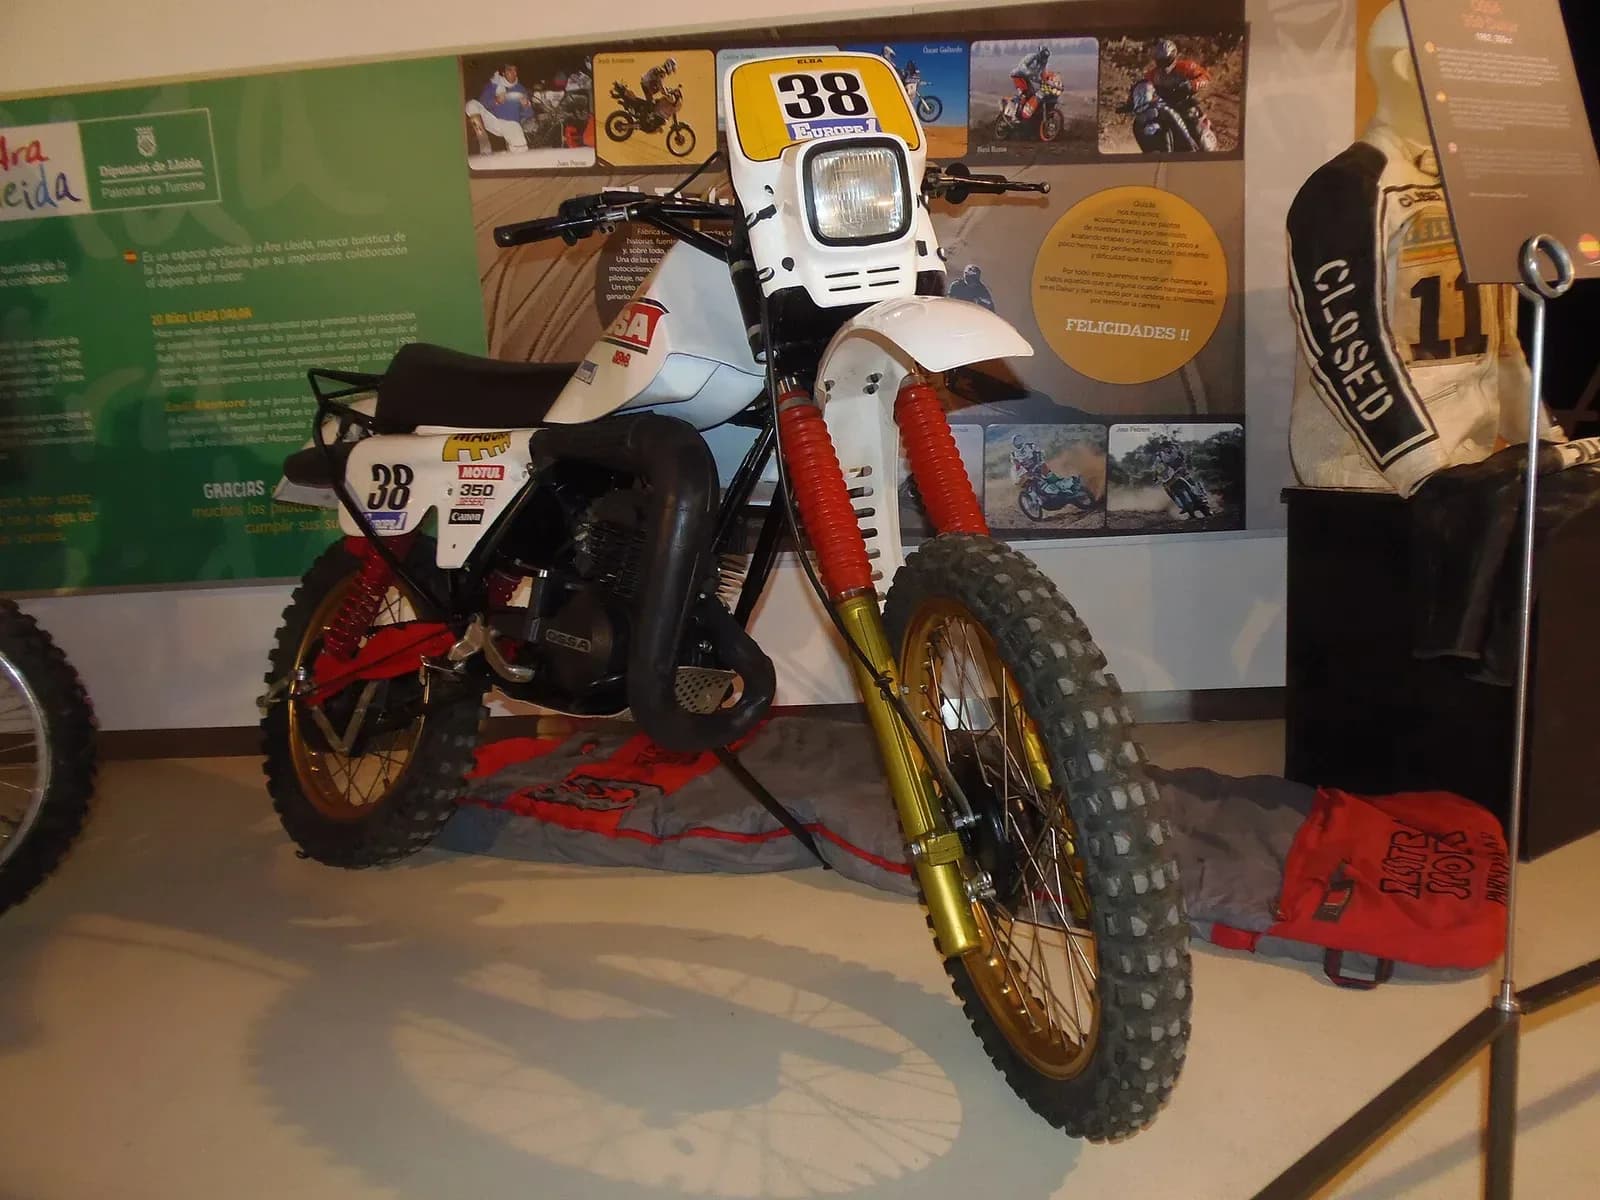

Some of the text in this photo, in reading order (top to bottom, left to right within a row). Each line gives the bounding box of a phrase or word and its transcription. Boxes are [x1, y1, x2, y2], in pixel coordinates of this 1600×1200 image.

[777, 72, 869, 119] 38
[394, 230, 407, 243] de
[629, 246, 648, 254] sobre
[616, 255, 630, 264] Una
[630, 255, 639, 264] de
[611, 283, 622, 291] Un
[1410, 271, 1489, 360] 11
[1065, 318, 1190, 341] FELICIDADES !!
[1313, 258, 1395, 421] CLOSED
[461, 466, 502, 479] MOTUL
[203, 479, 265, 500] GRACIAS
[367, 463, 414, 510] 38
[459, 483, 495, 497] 350
[450, 511, 482, 523] Canon
